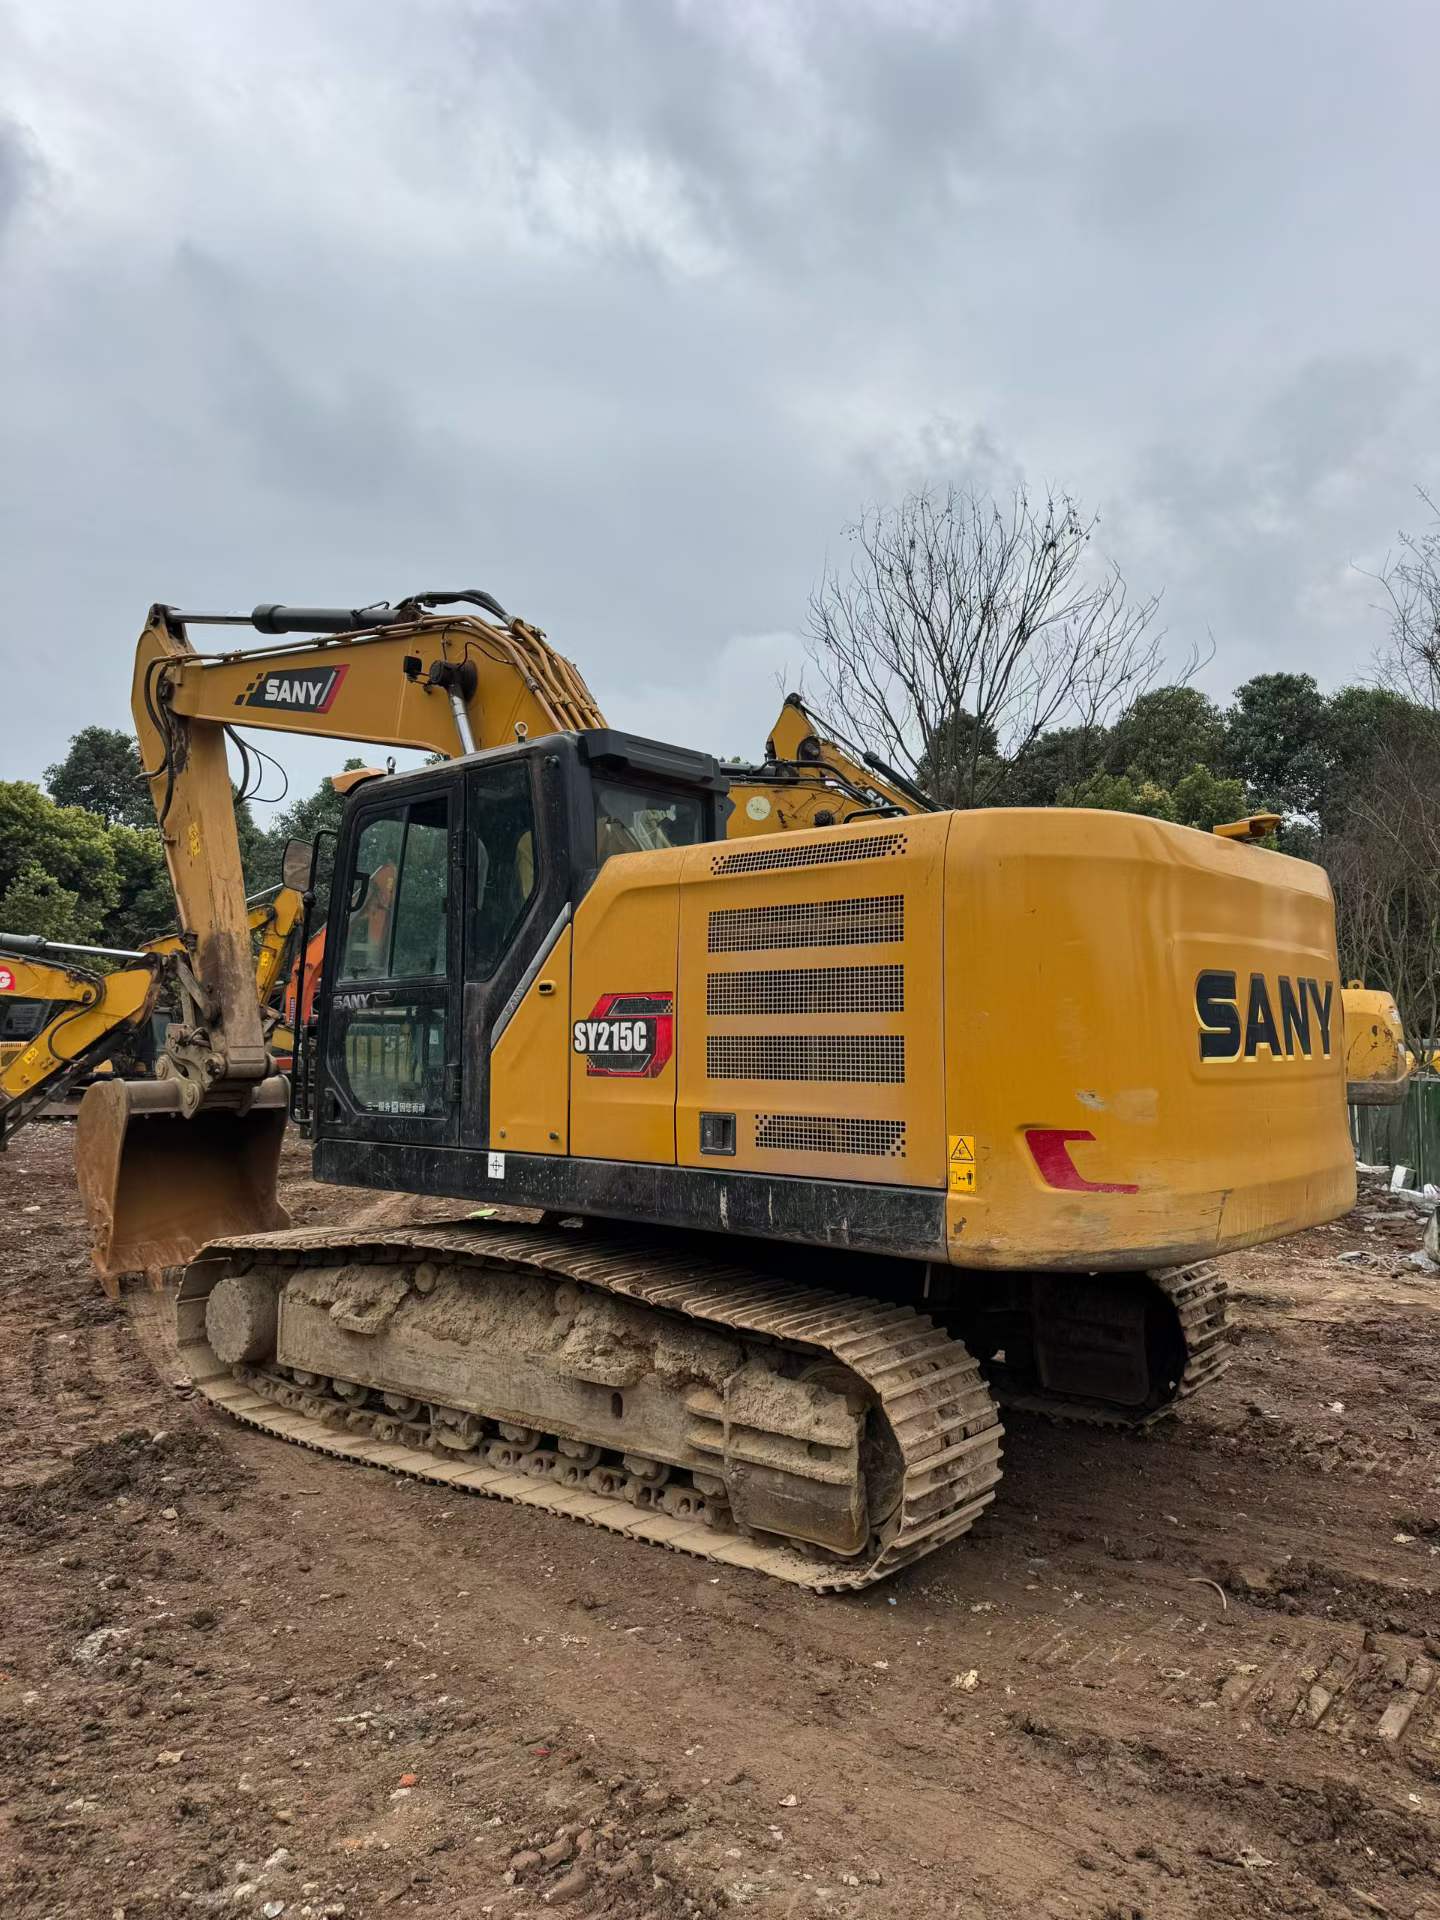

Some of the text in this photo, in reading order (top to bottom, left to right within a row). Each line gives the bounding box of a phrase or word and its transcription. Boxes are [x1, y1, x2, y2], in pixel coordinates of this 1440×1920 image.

[265, 678, 322, 705] SANY
[332, 993, 370, 1011] SANY
[1194, 969, 1334, 1064] SANY
[574, 1021, 648, 1053] SY215C
